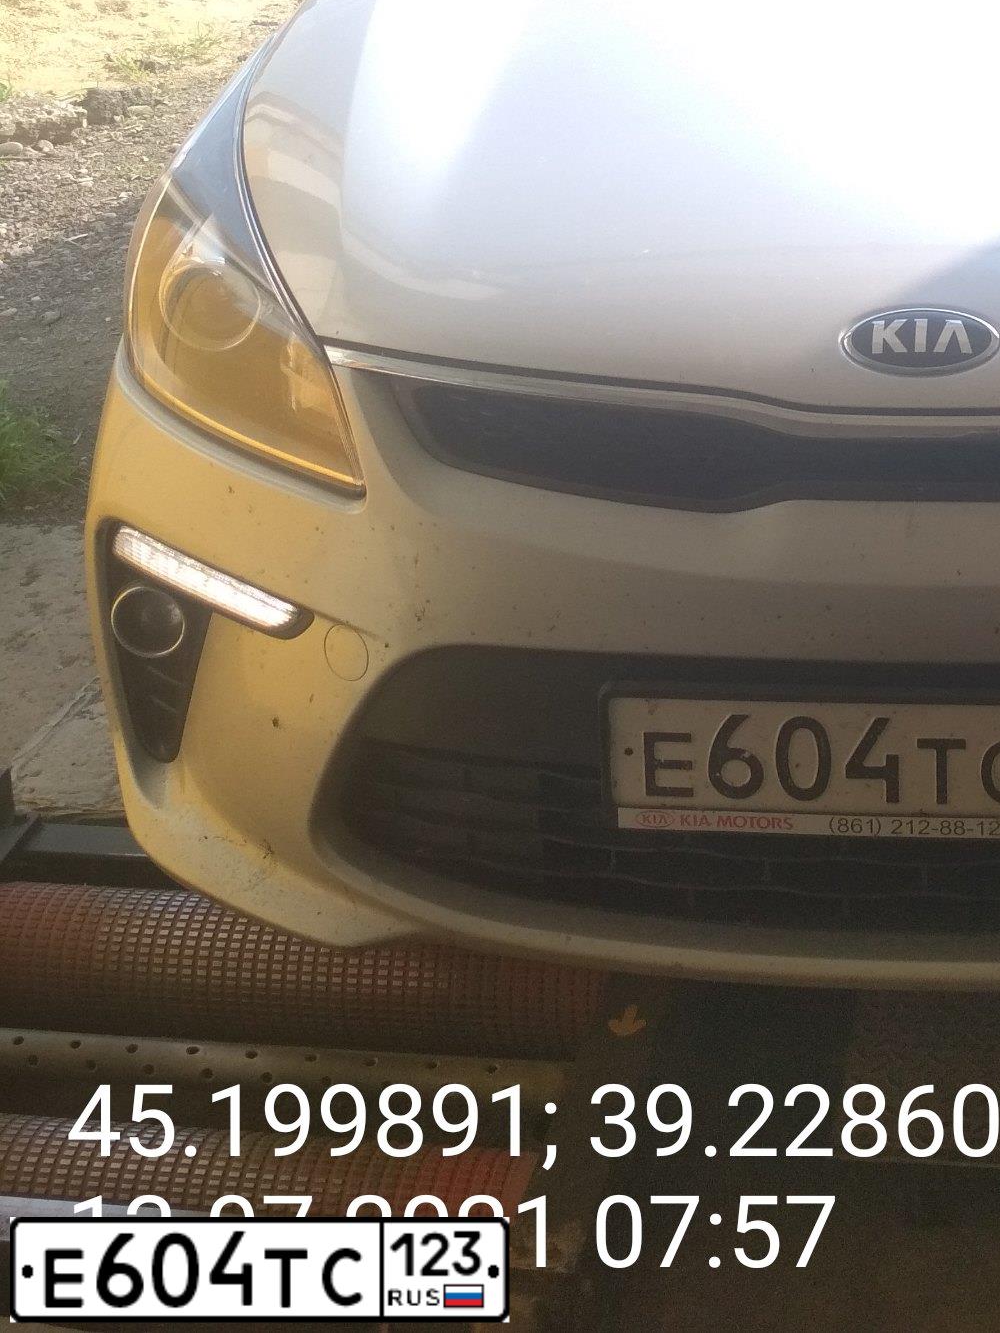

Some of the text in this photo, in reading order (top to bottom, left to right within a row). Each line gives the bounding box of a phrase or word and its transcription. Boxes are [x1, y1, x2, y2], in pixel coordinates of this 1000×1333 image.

[871, 318, 973, 354] KIA
[641, 812, 794, 831] KIA KIA MOTORS
[828, 816, 1000, 837] (861) 212-88-12
